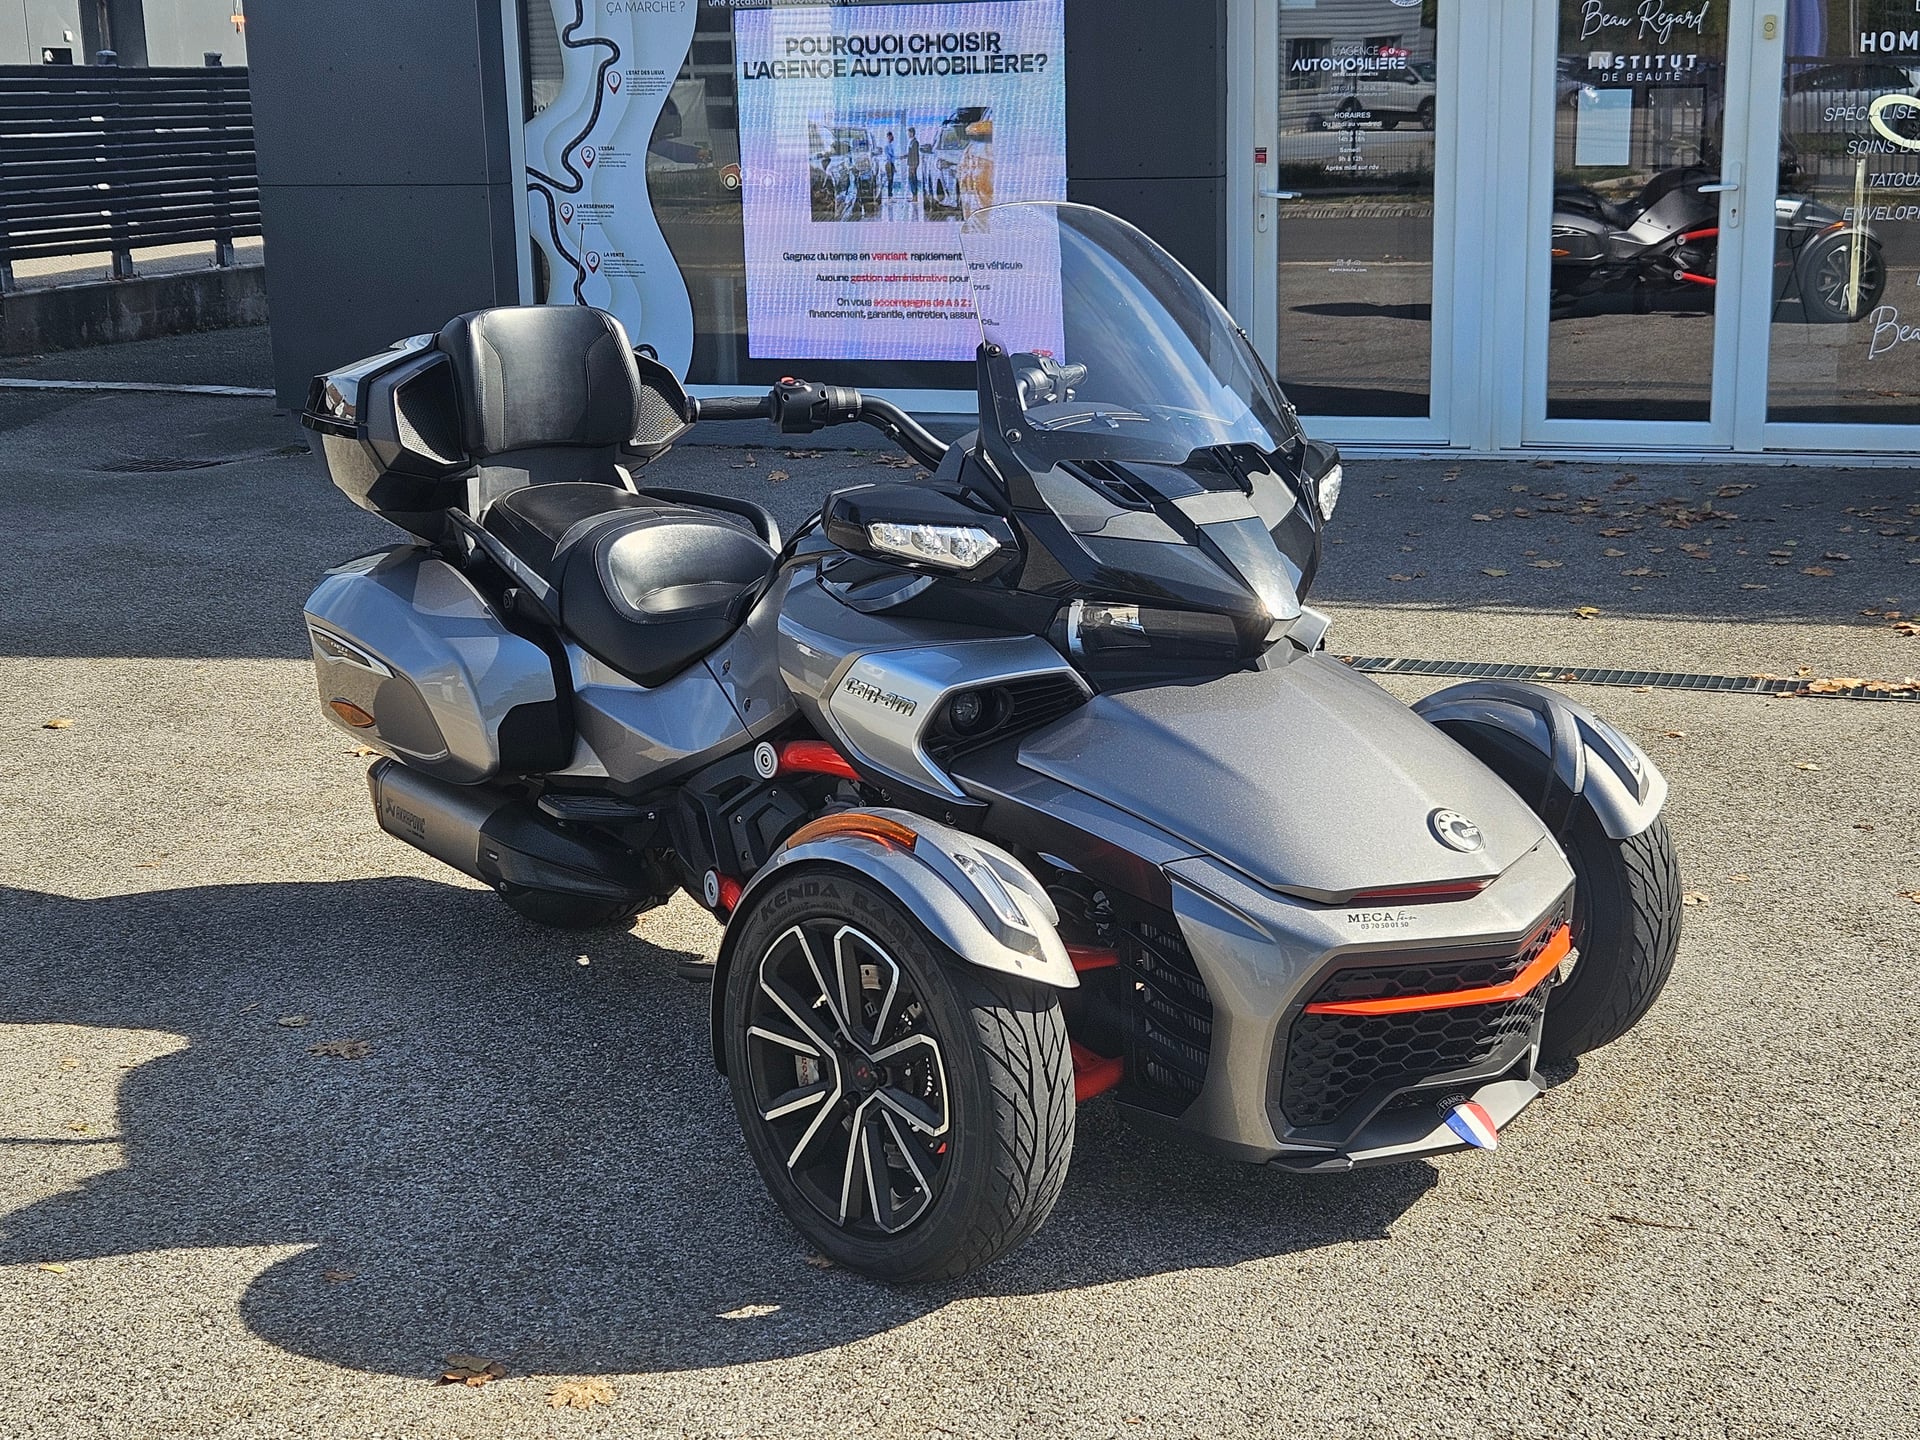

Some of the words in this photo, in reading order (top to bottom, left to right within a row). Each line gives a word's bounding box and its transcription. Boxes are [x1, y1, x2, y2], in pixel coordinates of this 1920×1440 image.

[605, 1, 622, 16] ÇA
[625, 1, 676, 13] MARCHE
[680, 1, 686, 13] ?
[1580, 0, 1632, 40] Beau
[1637, 0, 1710, 45] Regard
[785, 34, 904, 57] POURQUOI
[908, 31, 1001, 54] CHOISIR
[743, 58, 847, 80] L'AGENCE
[850, 51, 1048, 77] AUTOMOBILIÈRE?
[1587, 54, 1697, 70] INSTITUT
[1602, 72, 1618, 81] DE
[585, 149, 592, 158] 2
[1846, 140, 1897, 154] SOINS
[1843, 205, 1920, 220] ENVELOP
[782, 252, 816, 262] Gagnez
[817, 252, 829, 261] du
[829, 253, 858, 262] temps
[871, 252, 908, 261] vendant
[910, 252, 963, 262] rapidement
[986, 261, 1023, 270] véhicule
[816, 274, 849, 282] Aucune
[850, 273, 884, 284] gestion
[884, 273, 948, 283] administrative
[949, 275, 970, 284] pour
[837, 298, 850, 306] On
[851, 299, 873, 307] vous
[874, 298, 931, 308] accompagne
[933, 298, 945, 307] de
[809, 309, 866, 319] financement,
[867, 309, 905, 320] garantie,
[906, 310, 949, 320] entretien,
[760, 881, 841, 922] KENDA
[1347, 912, 1394, 923] MECA
